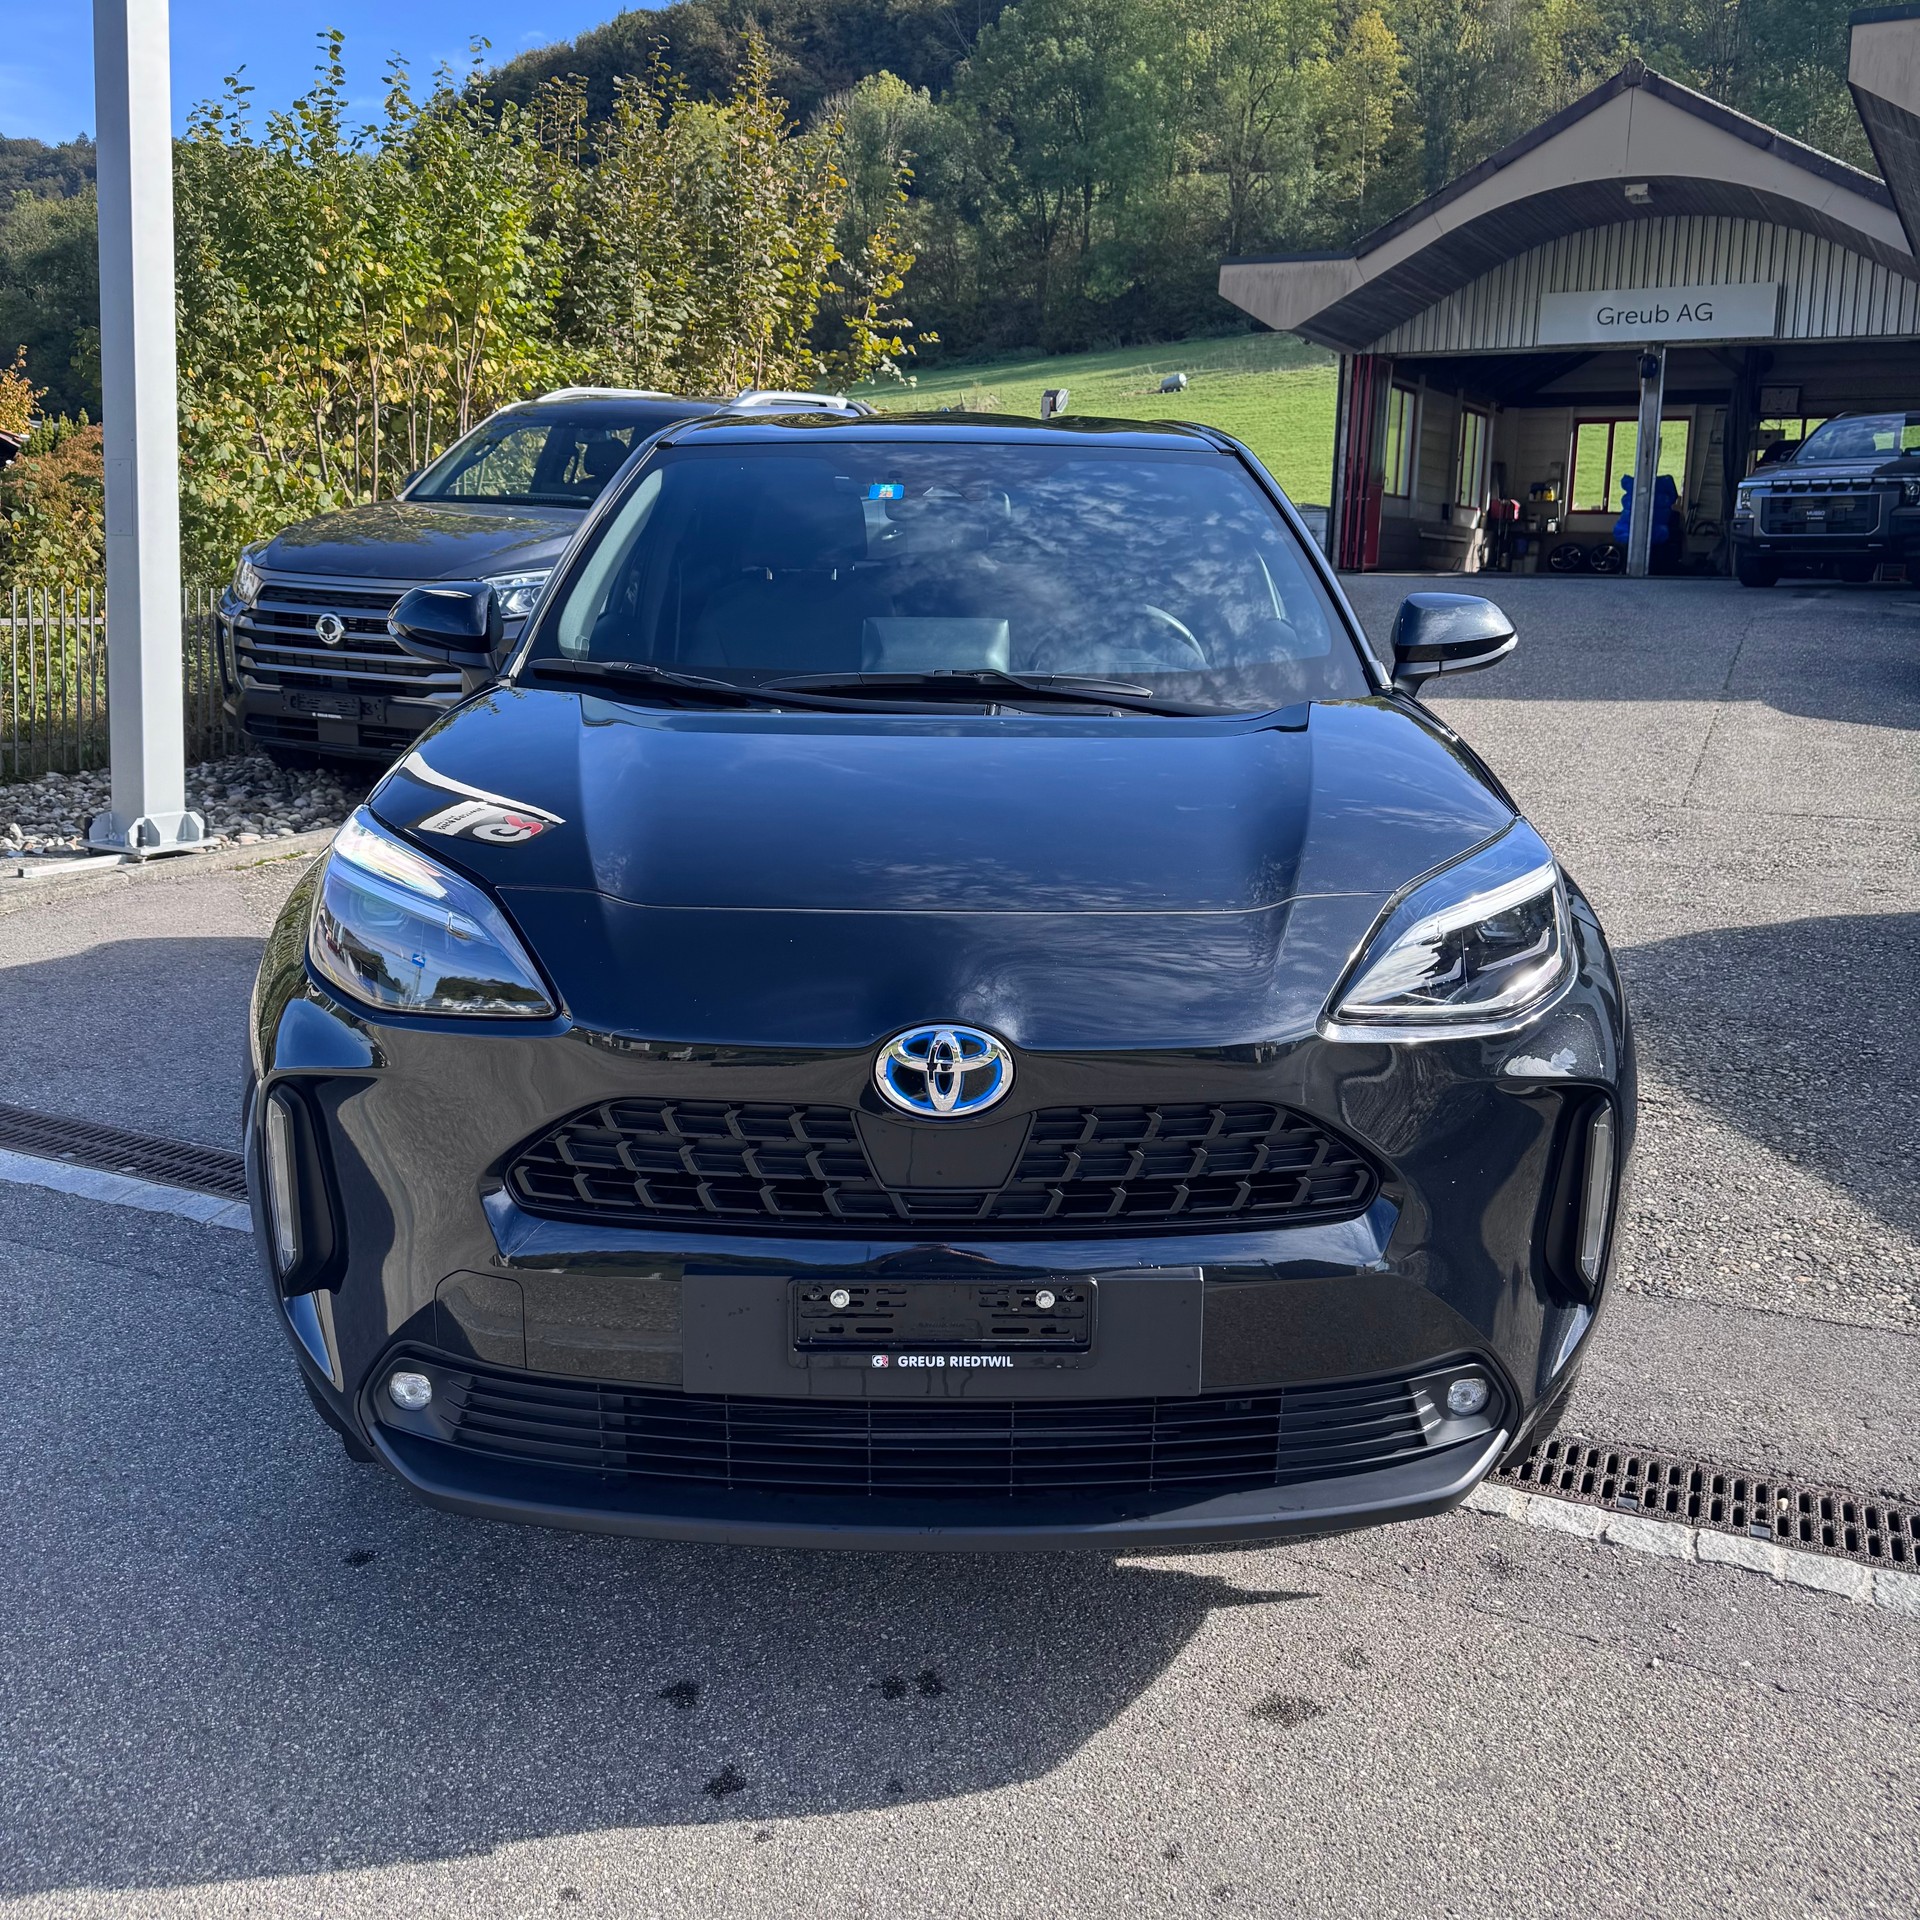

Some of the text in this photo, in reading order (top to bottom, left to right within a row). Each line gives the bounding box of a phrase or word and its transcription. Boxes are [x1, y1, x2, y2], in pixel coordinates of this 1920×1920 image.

[1597, 302, 1713, 325] Greub AG
[897, 1355, 945, 1368] GREUB
[949, 1355, 1014, 1368] RIEDTWIL
